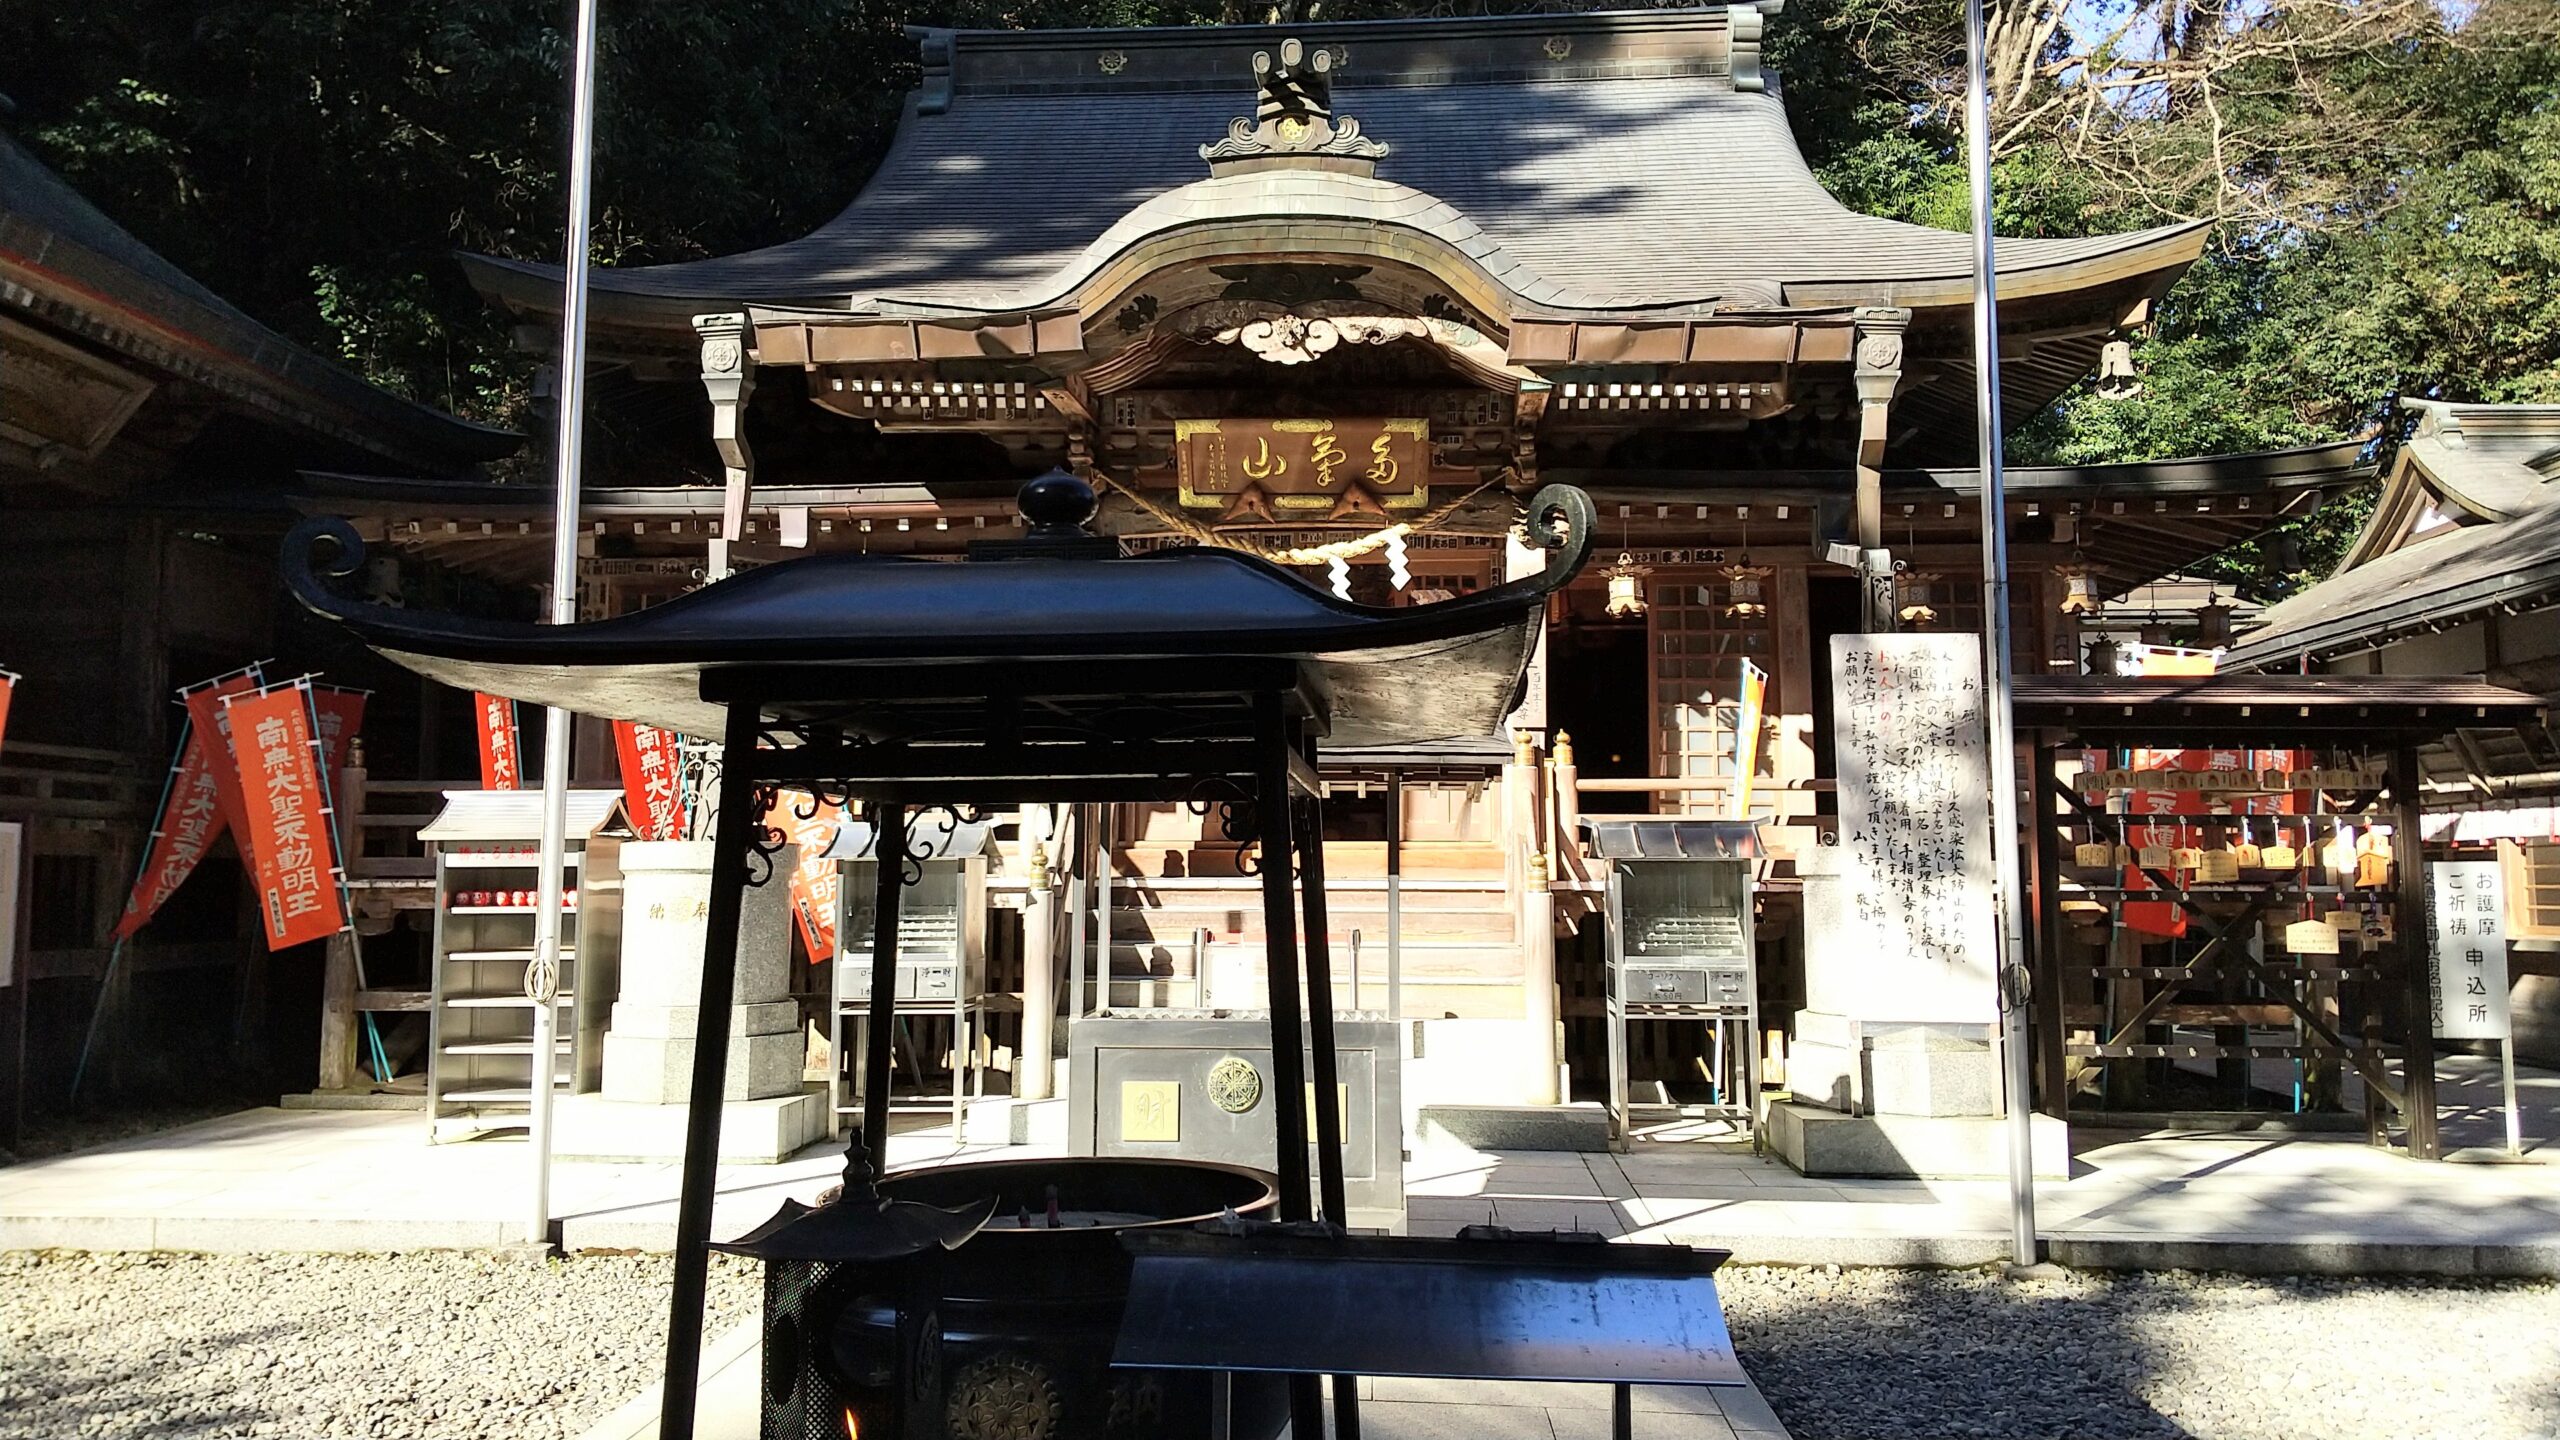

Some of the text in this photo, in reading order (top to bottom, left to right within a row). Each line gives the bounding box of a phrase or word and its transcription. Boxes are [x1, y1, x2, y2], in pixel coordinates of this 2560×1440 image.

[256, 716, 322, 919] 南無大聖不動明王
[2447, 872, 2467, 936] ご祈祷
[2476, 872, 2497, 936] お護摩
[2465, 947, 2488, 1024] 申込所
